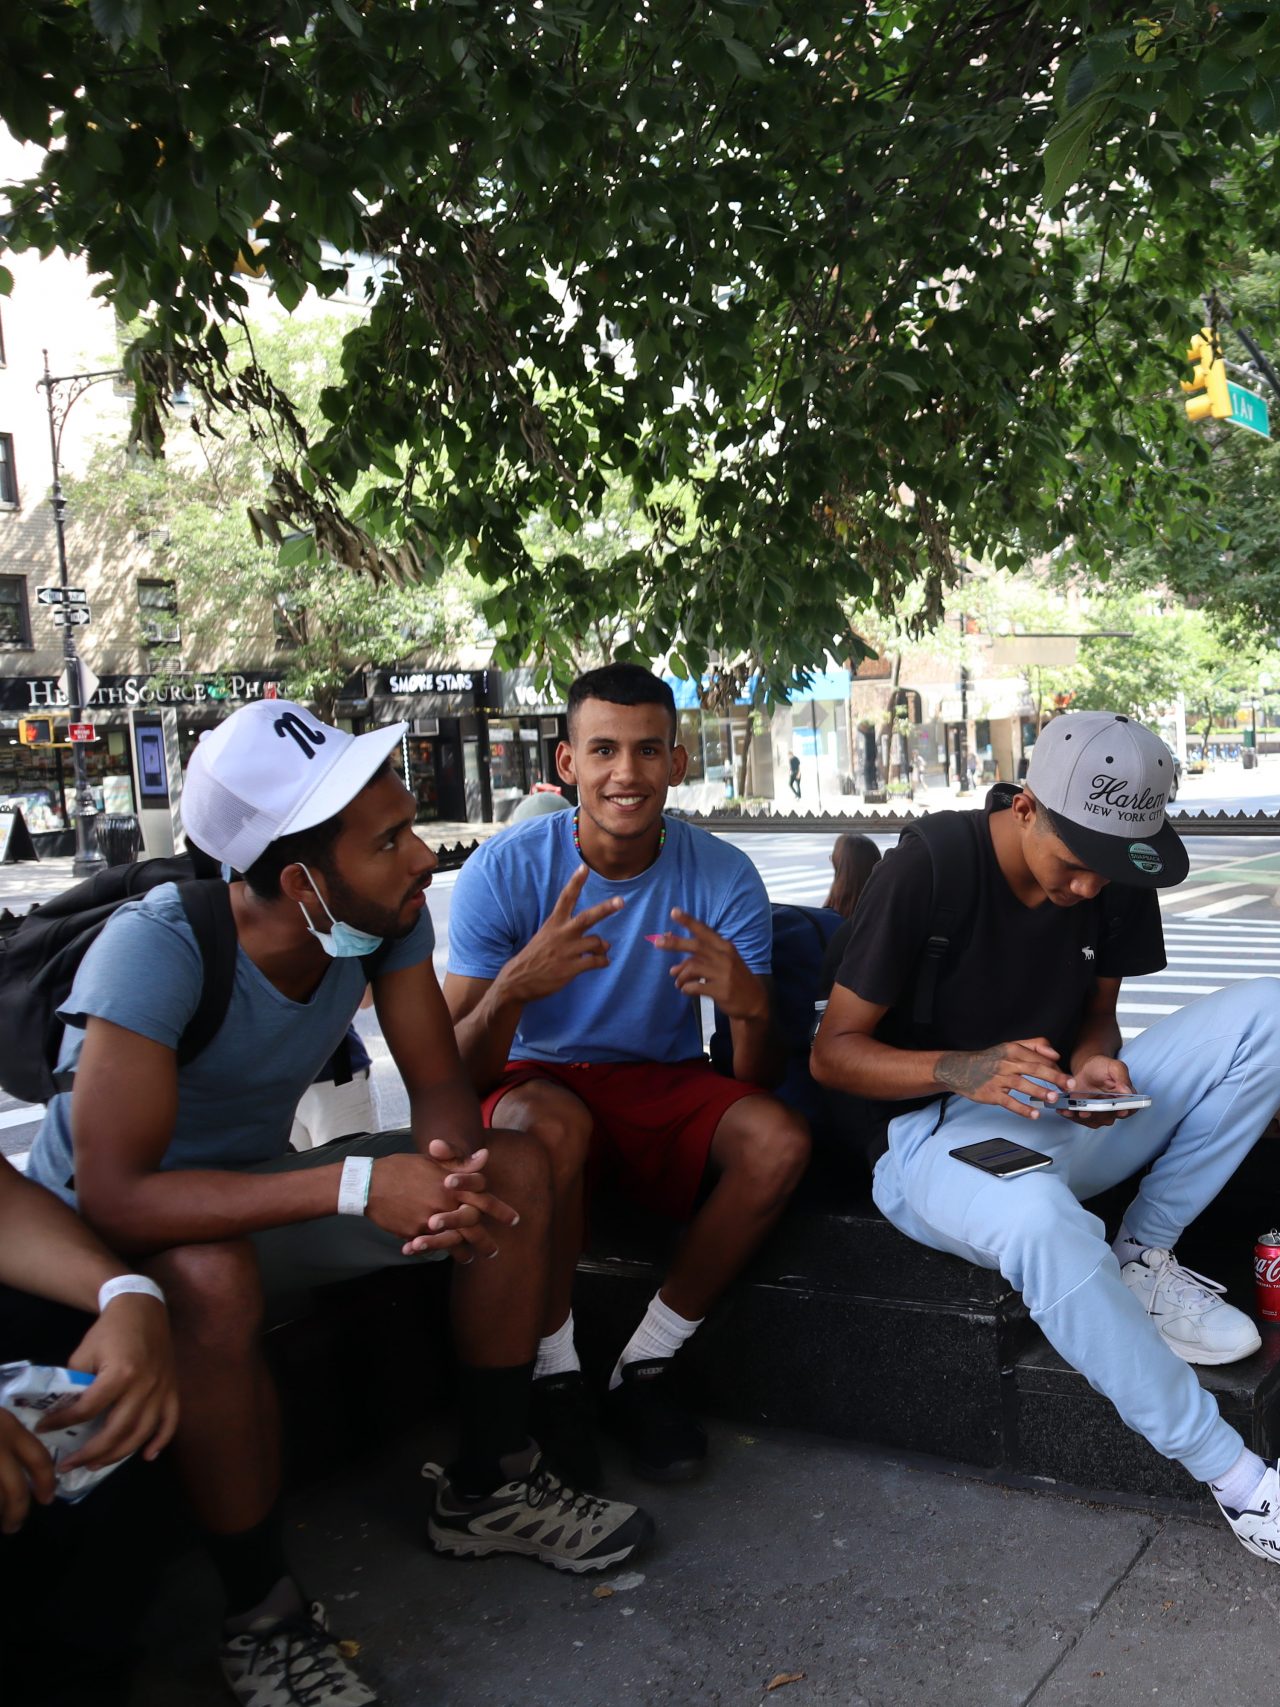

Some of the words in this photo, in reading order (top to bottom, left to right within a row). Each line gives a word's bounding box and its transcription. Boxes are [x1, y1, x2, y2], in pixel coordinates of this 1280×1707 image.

[389, 674, 434, 693] SMOKE
[435, 672, 473, 692] STARS
[1089, 774, 1165, 810] Harlem
[1083, 801, 1112, 817] NEW
[1118, 810, 1146, 822] YORK
